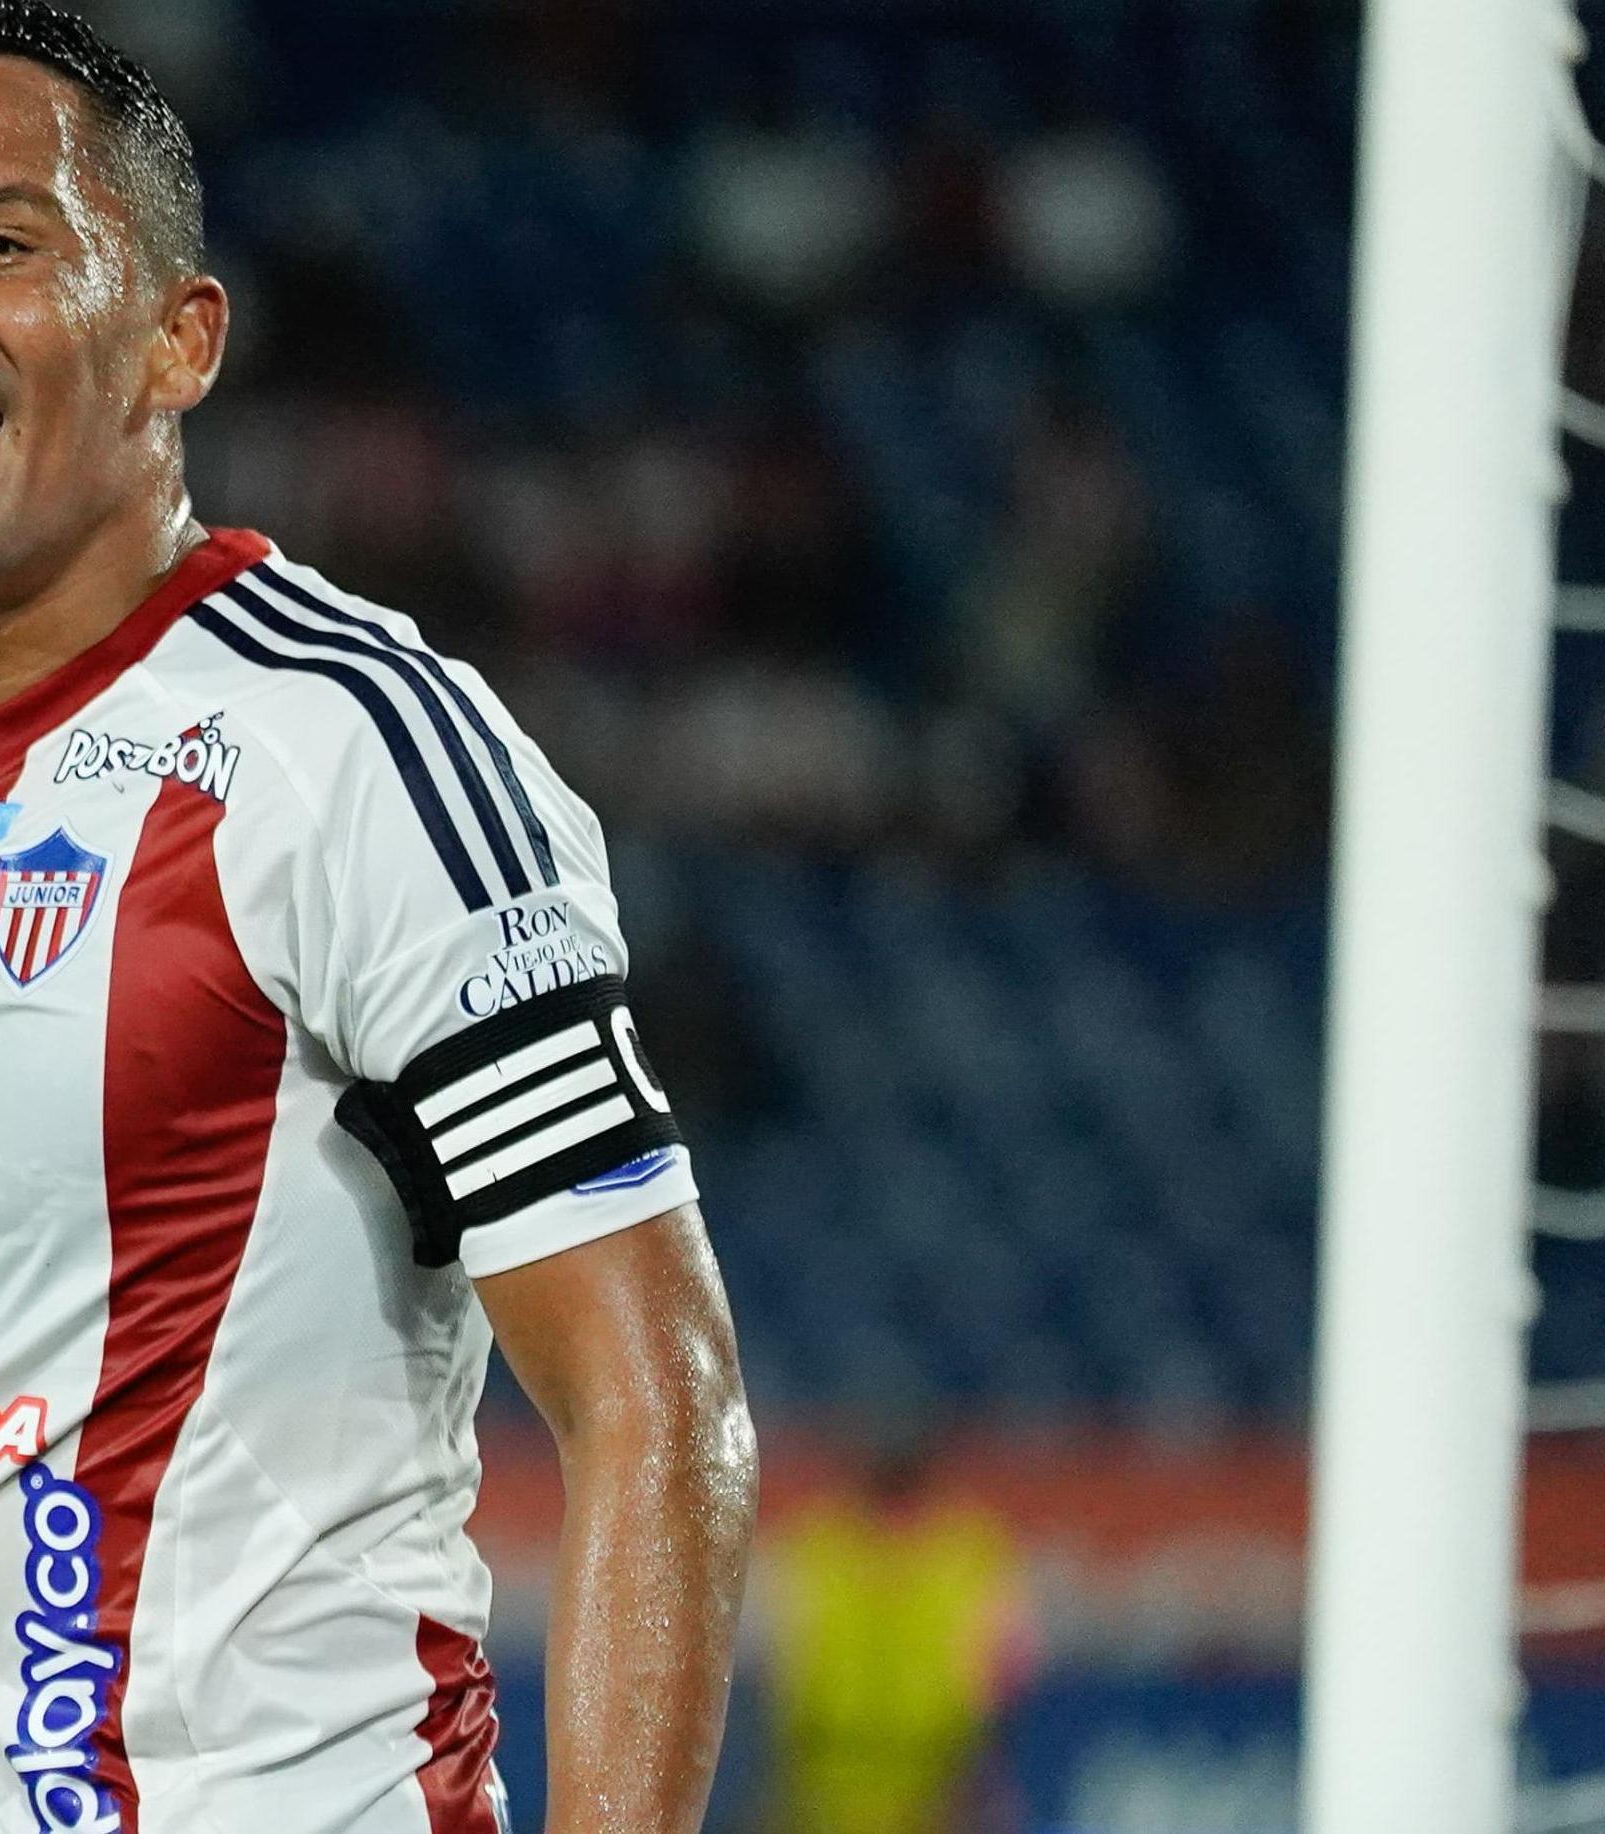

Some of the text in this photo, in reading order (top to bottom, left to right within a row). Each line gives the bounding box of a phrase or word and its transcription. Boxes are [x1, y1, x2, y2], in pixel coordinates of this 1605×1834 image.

[9, 885, 80, 904] JUNIOR
[491, 944, 555, 976] VIEJO
[459, 944, 608, 1017] CALDAS
